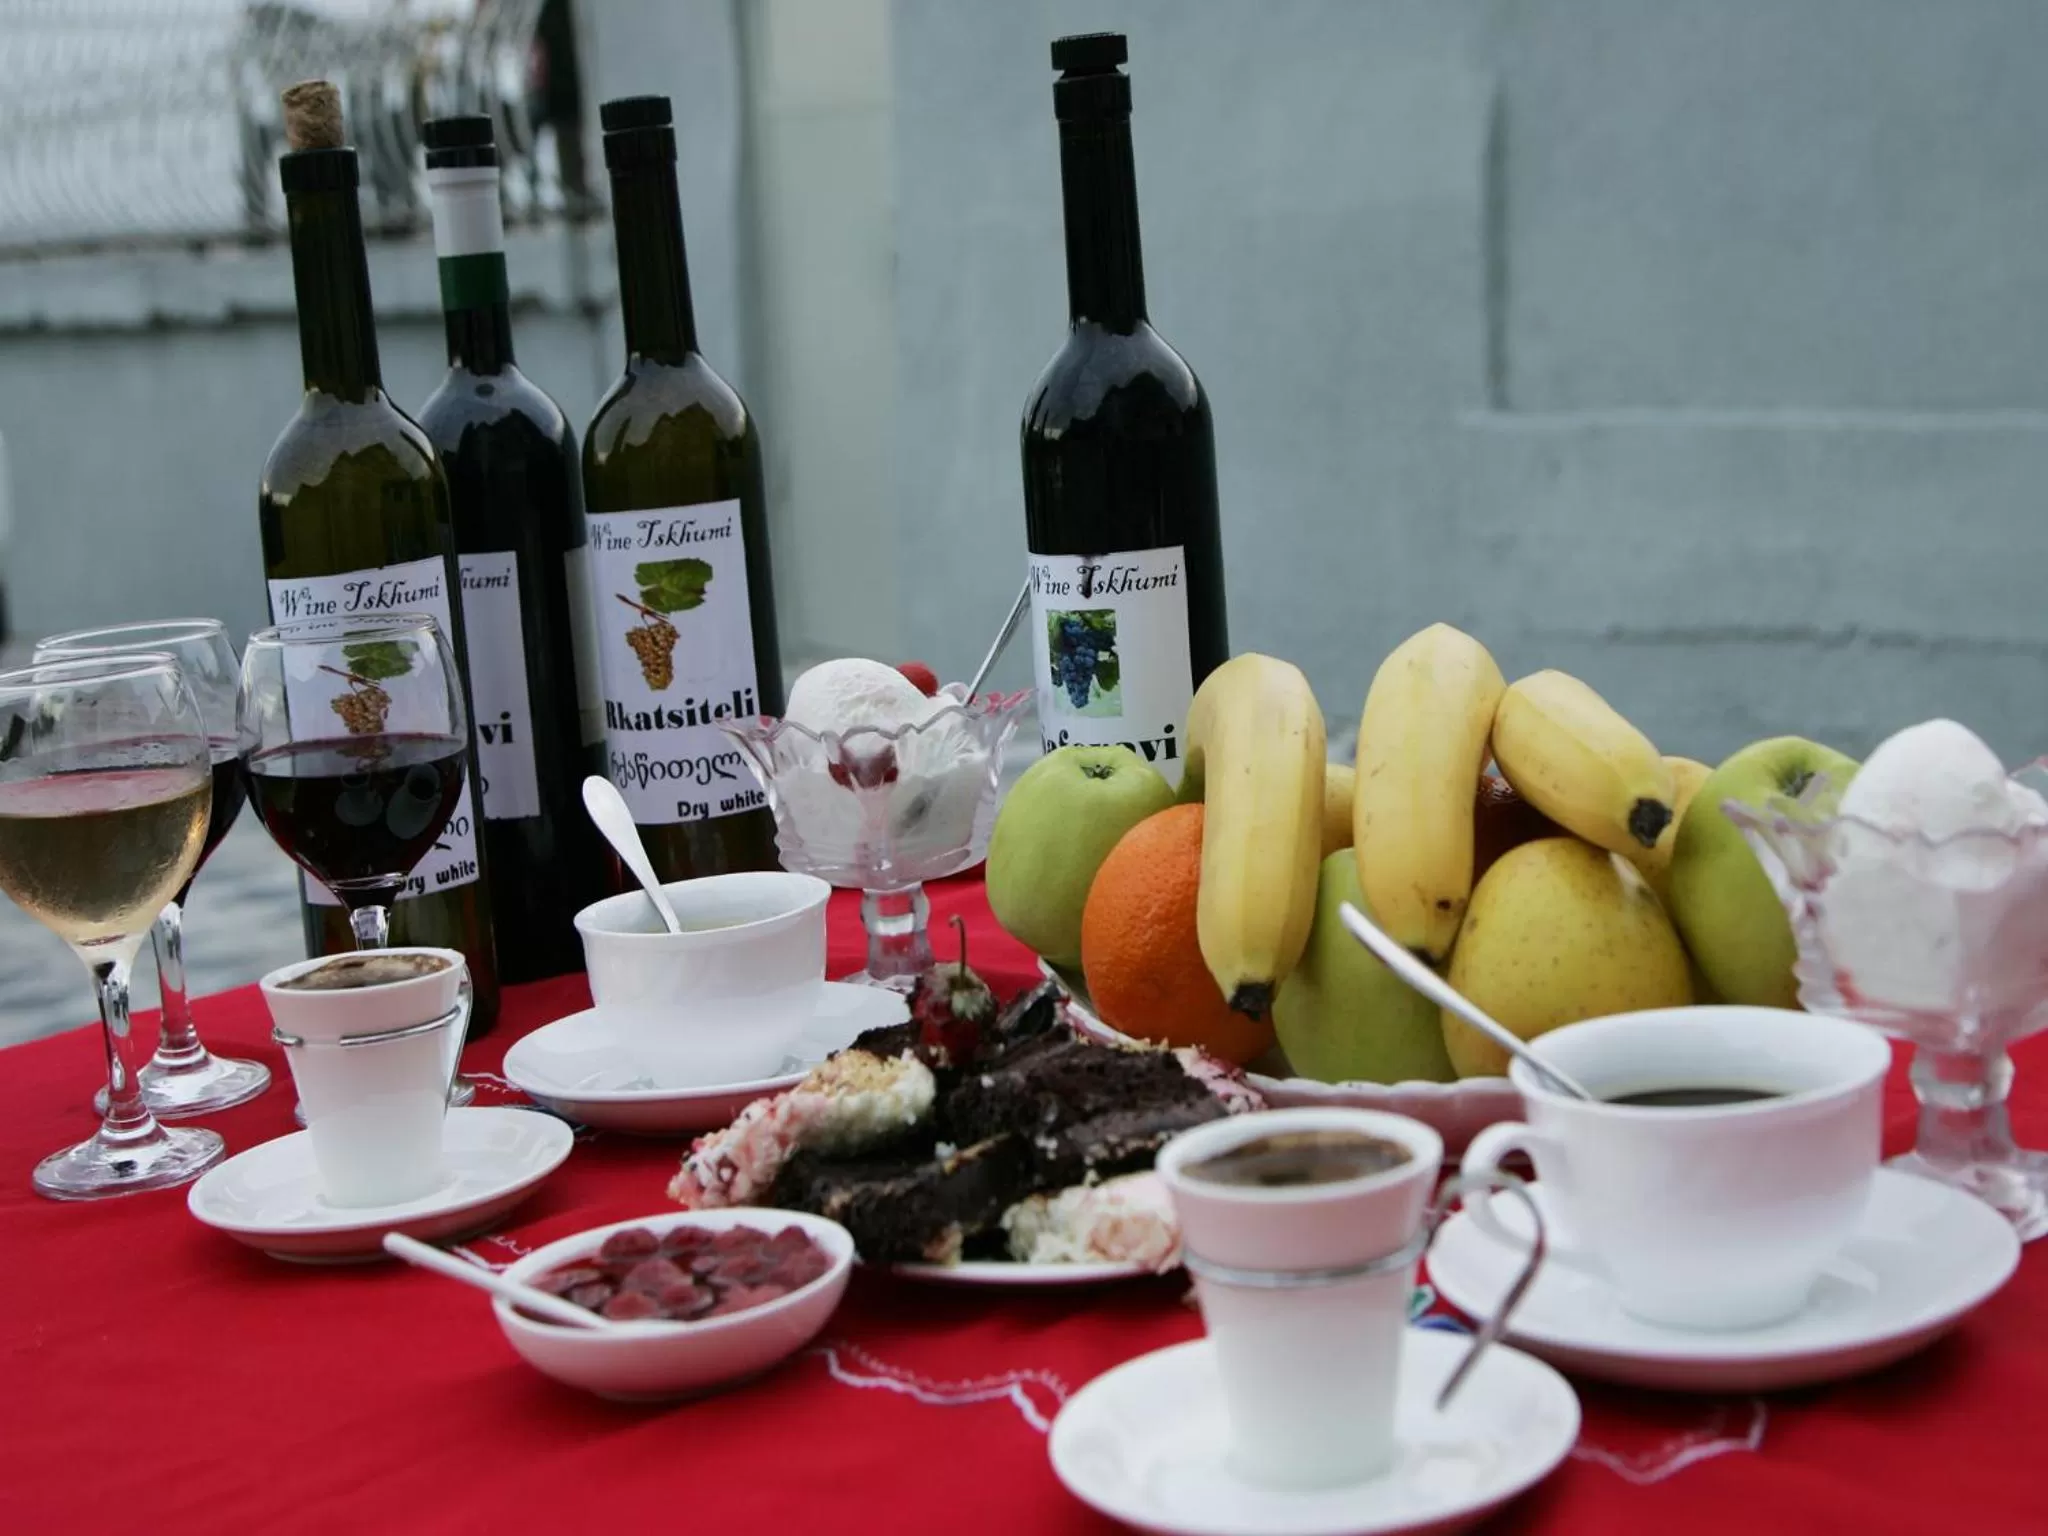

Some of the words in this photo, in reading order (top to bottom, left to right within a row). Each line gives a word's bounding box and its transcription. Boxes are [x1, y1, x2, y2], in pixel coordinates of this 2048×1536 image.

[590, 521, 632, 551] Wine
[636, 516, 733, 549] Tskhumi
[279, 586, 337, 618] Wine
[343, 575, 440, 612] Tskhumi
[1030, 564, 1071, 596] Wine
[1076, 564, 1178, 600] Tskhumi
[604, 688, 755, 732] Rkatsiteli
[610, 751, 748, 790] რქაწითელ
[677, 801, 709, 819] Dry
[720, 790, 765, 812] white
[436, 860, 476, 884] white
